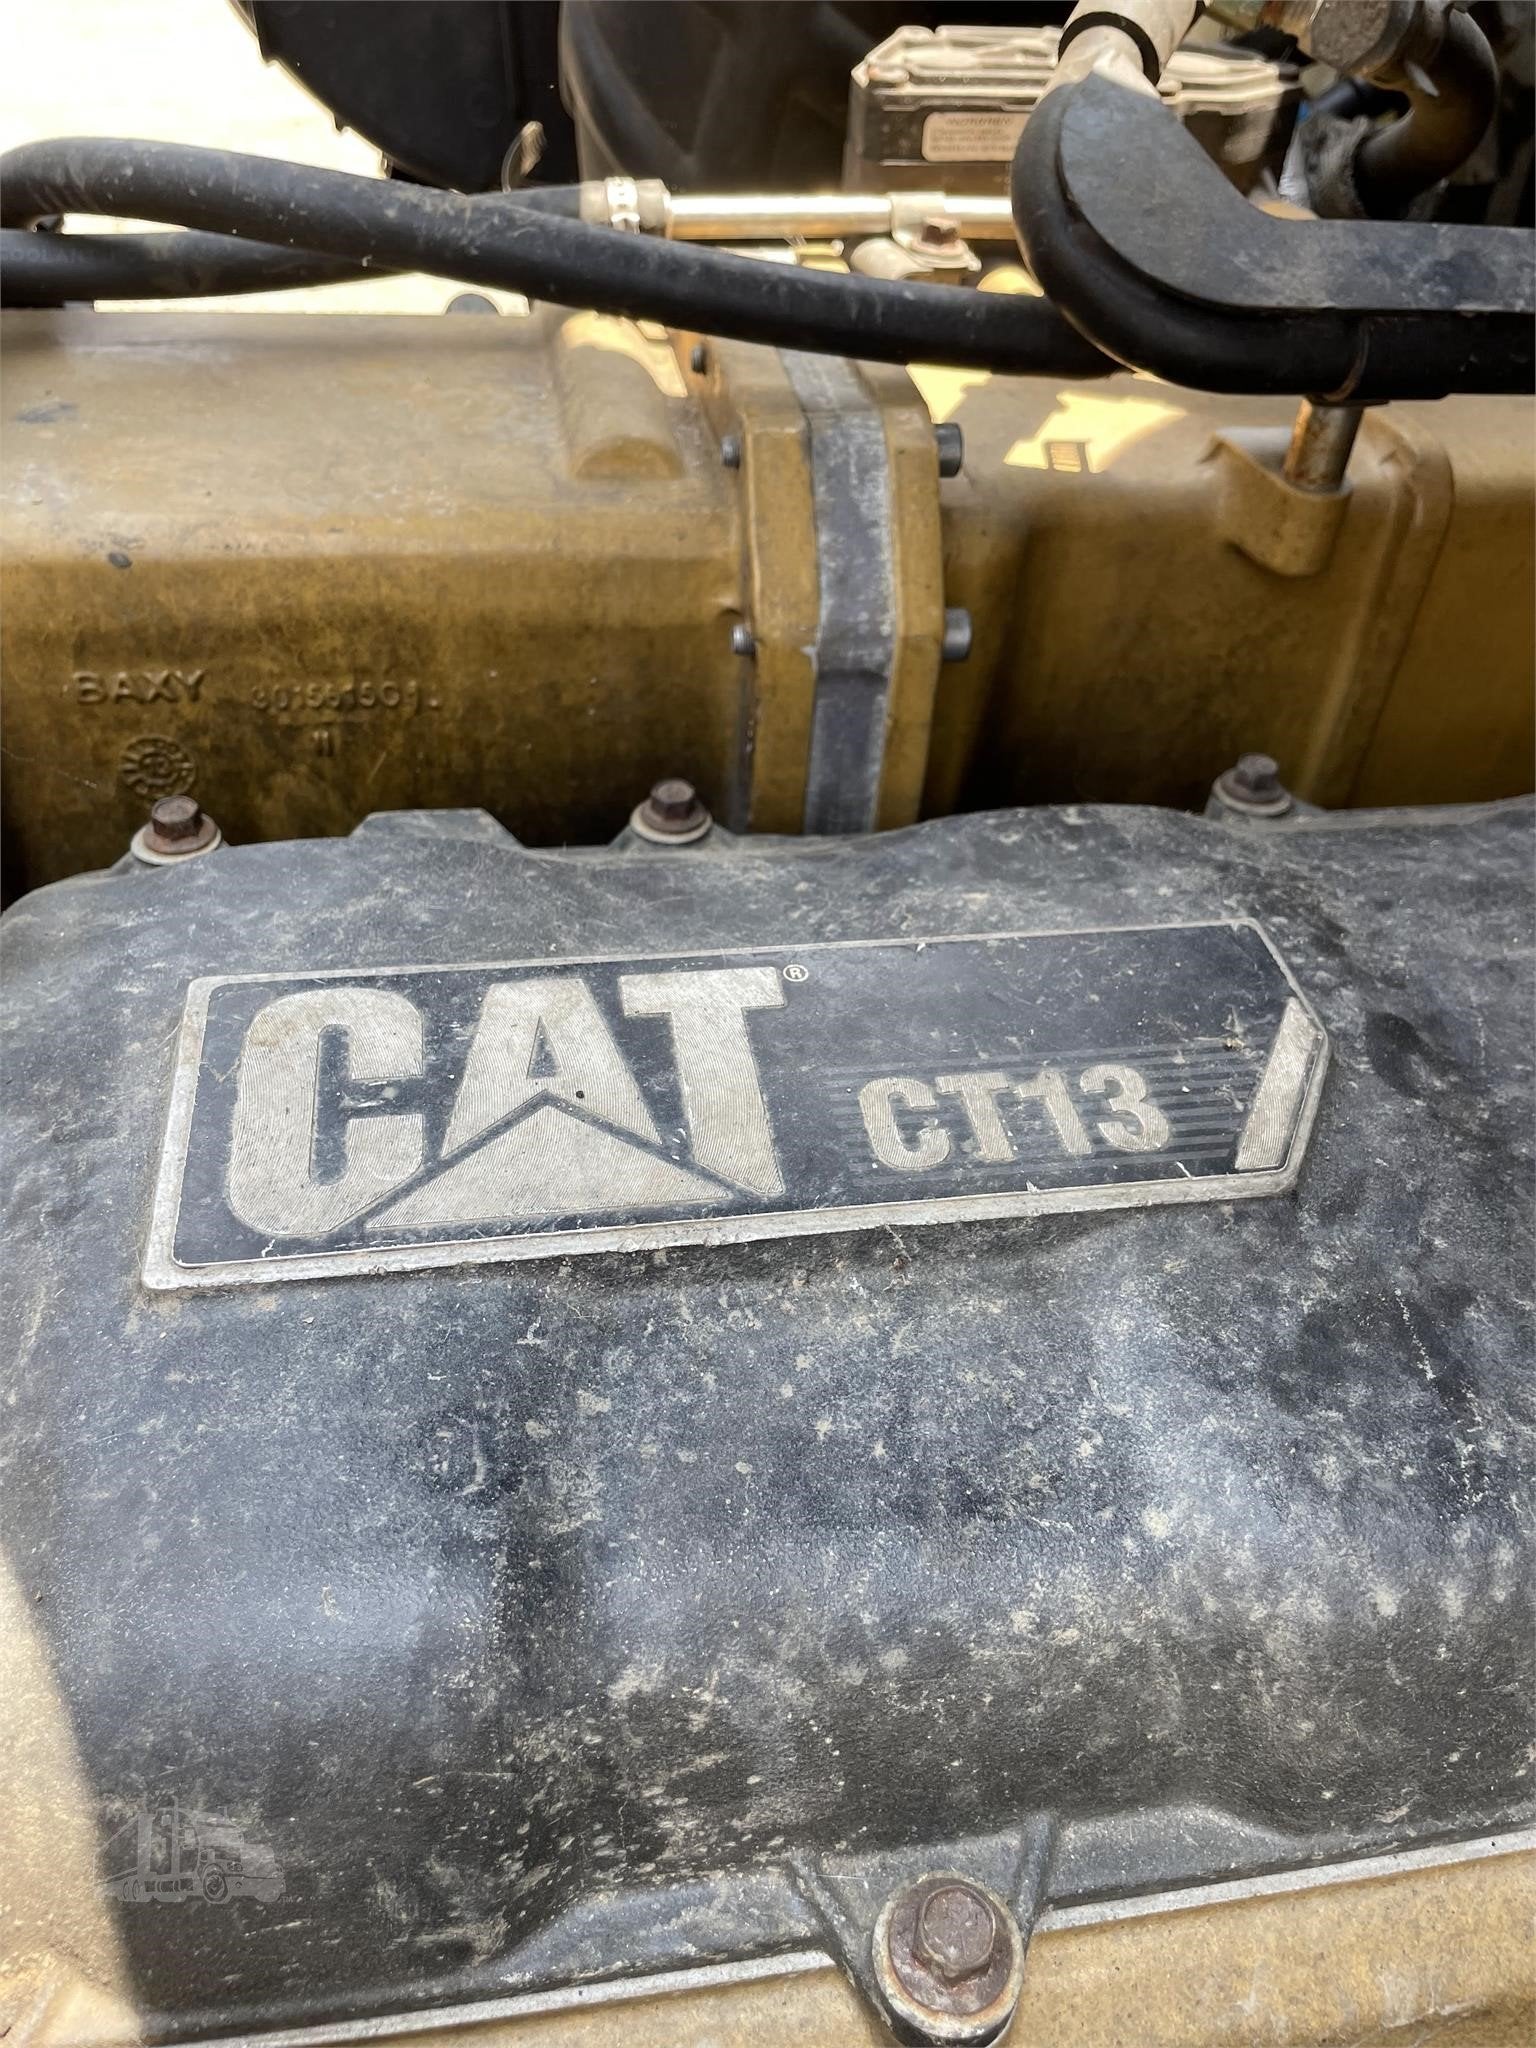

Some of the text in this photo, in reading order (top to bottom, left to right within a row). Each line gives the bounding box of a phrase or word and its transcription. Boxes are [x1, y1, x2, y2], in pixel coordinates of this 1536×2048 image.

[72, 670, 209, 704] BAXY
[228, 966, 785, 1236] CAT
[858, 1063, 1171, 1170] CT13
